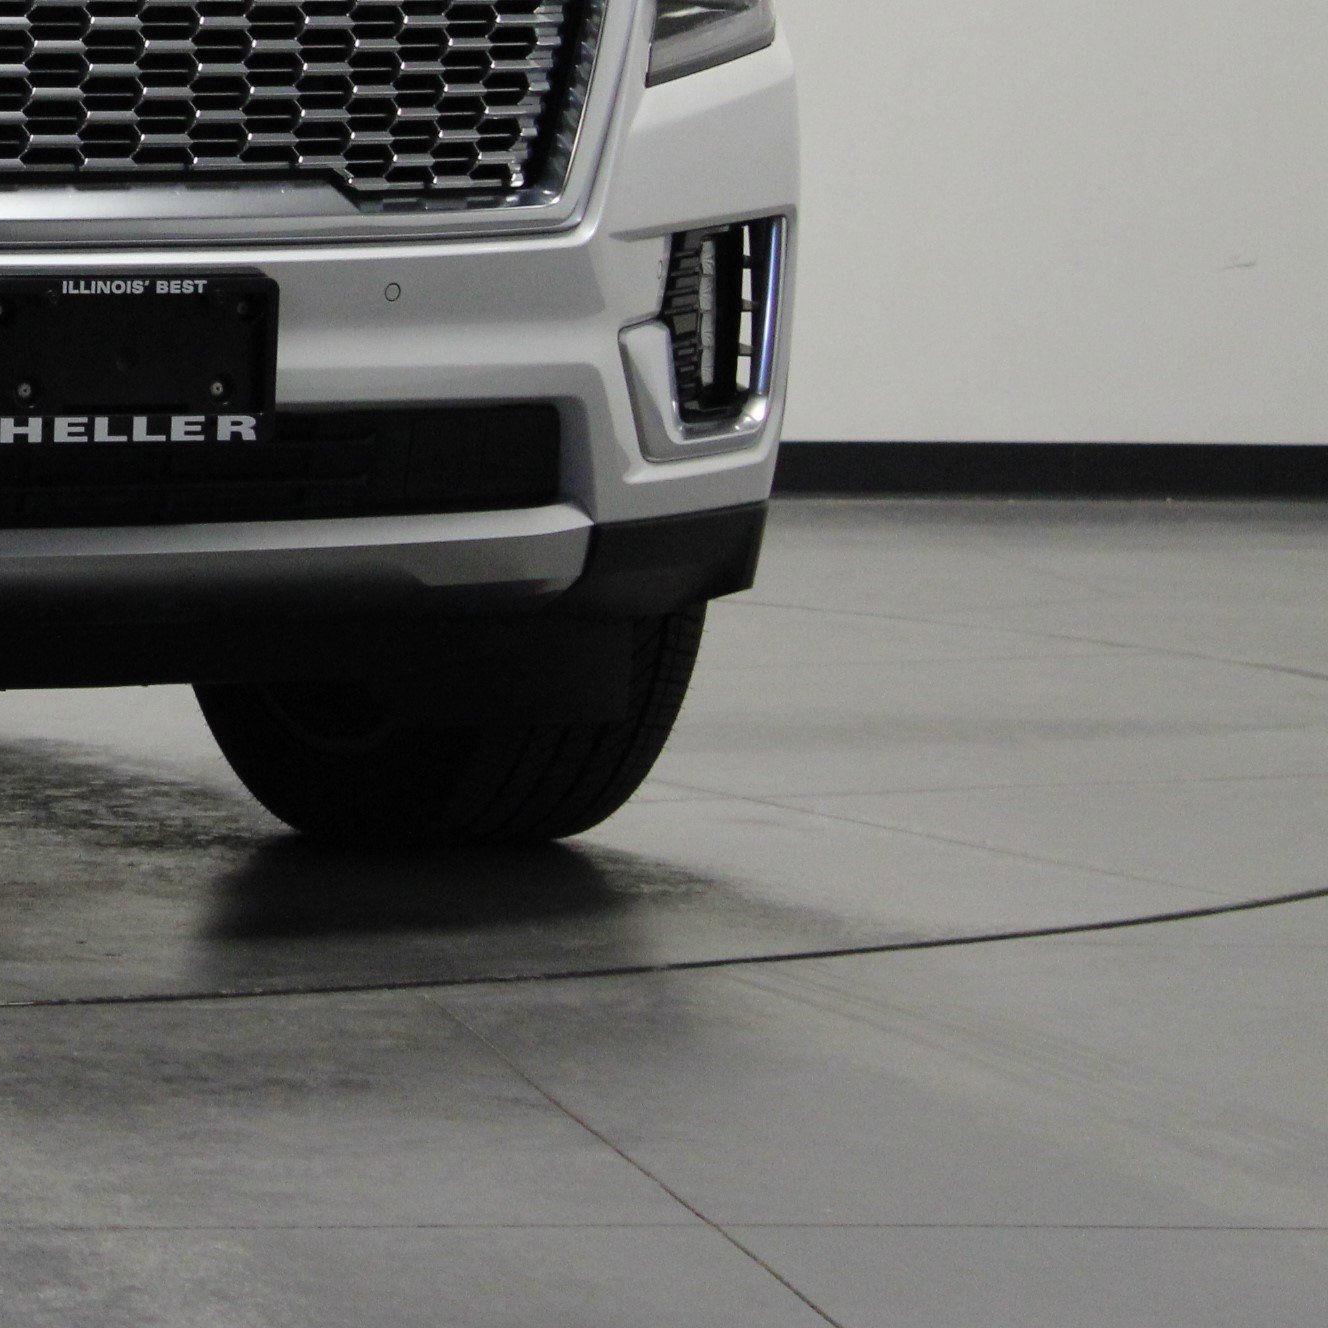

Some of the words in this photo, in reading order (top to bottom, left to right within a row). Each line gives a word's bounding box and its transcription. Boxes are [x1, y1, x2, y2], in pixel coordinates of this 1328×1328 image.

[61, 279, 150, 295] ILLINOIS'
[155, 279, 208, 295] BEST
[0, 415, 257, 444] HELLER
